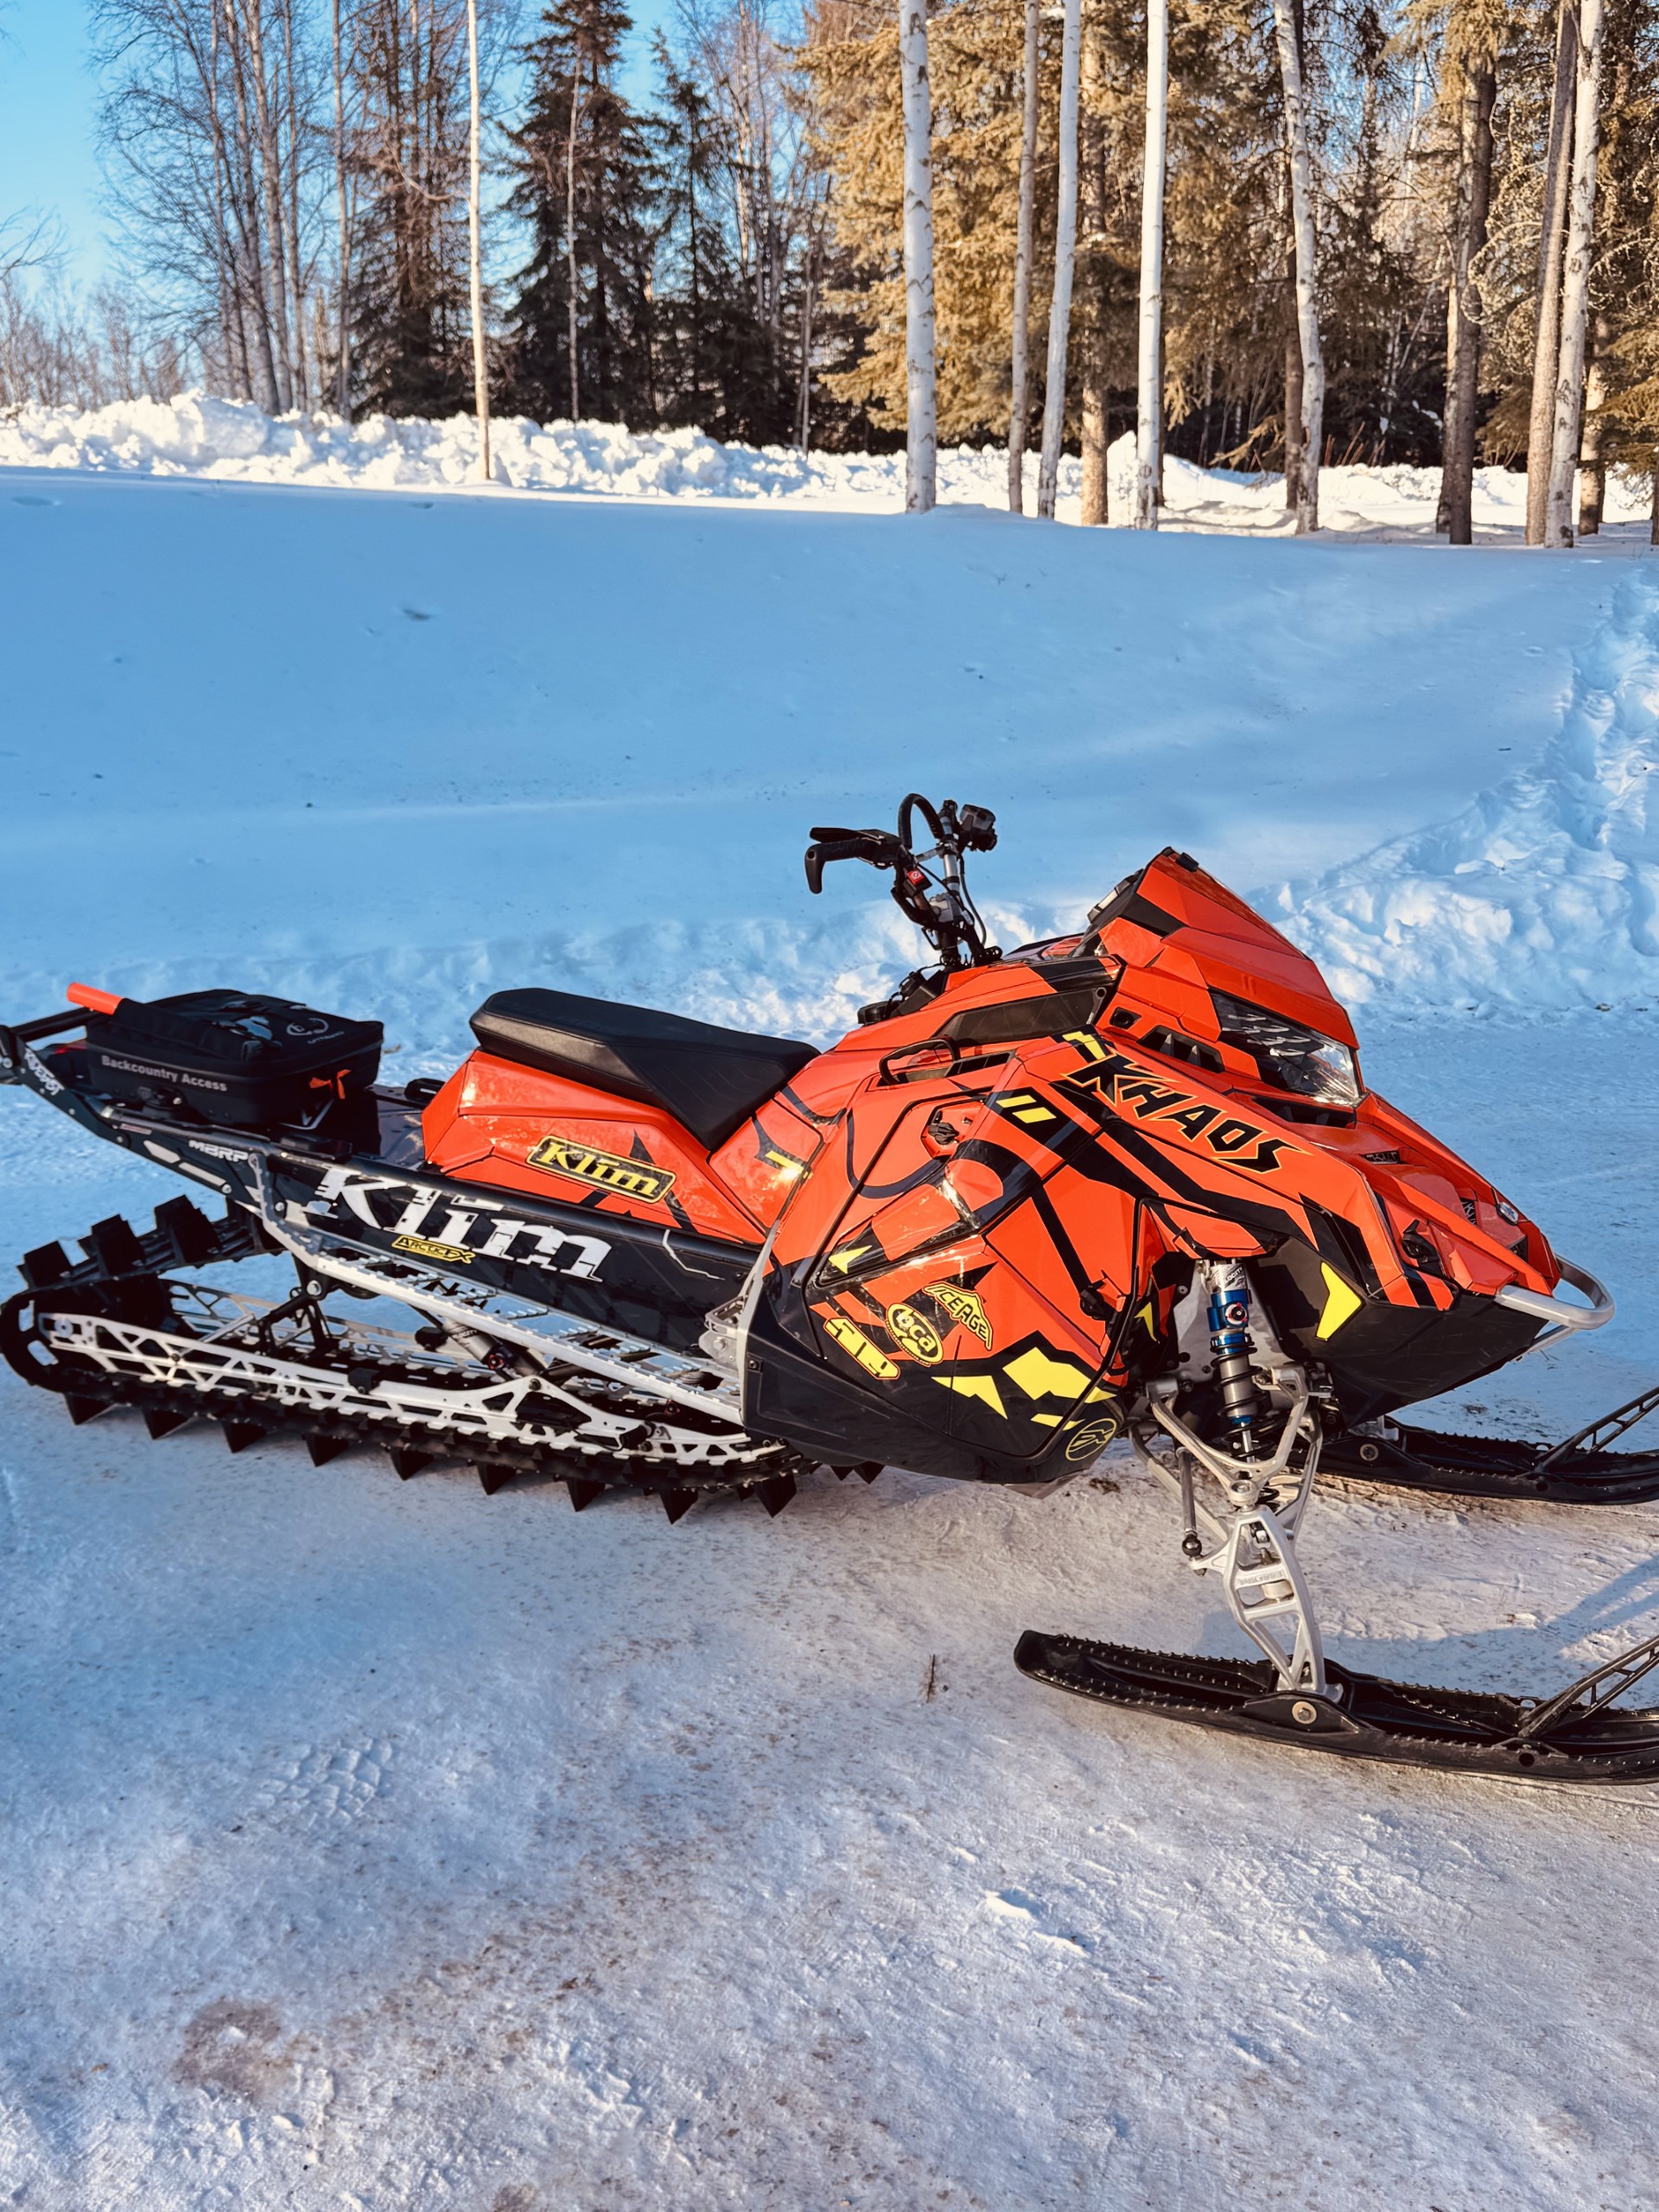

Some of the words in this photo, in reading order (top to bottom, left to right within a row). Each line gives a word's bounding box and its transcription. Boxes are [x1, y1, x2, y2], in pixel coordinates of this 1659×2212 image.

[101, 1055, 178, 1083] Backcountry
[181, 1073, 228, 1091] Access
[1061, 1050, 1313, 1173] KHAOS
[188, 1140, 248, 1162] MBRP
[538, 1137, 660, 1198] Klim
[315, 1166, 614, 1282] Klim
[895, 1308, 937, 1353] bca
